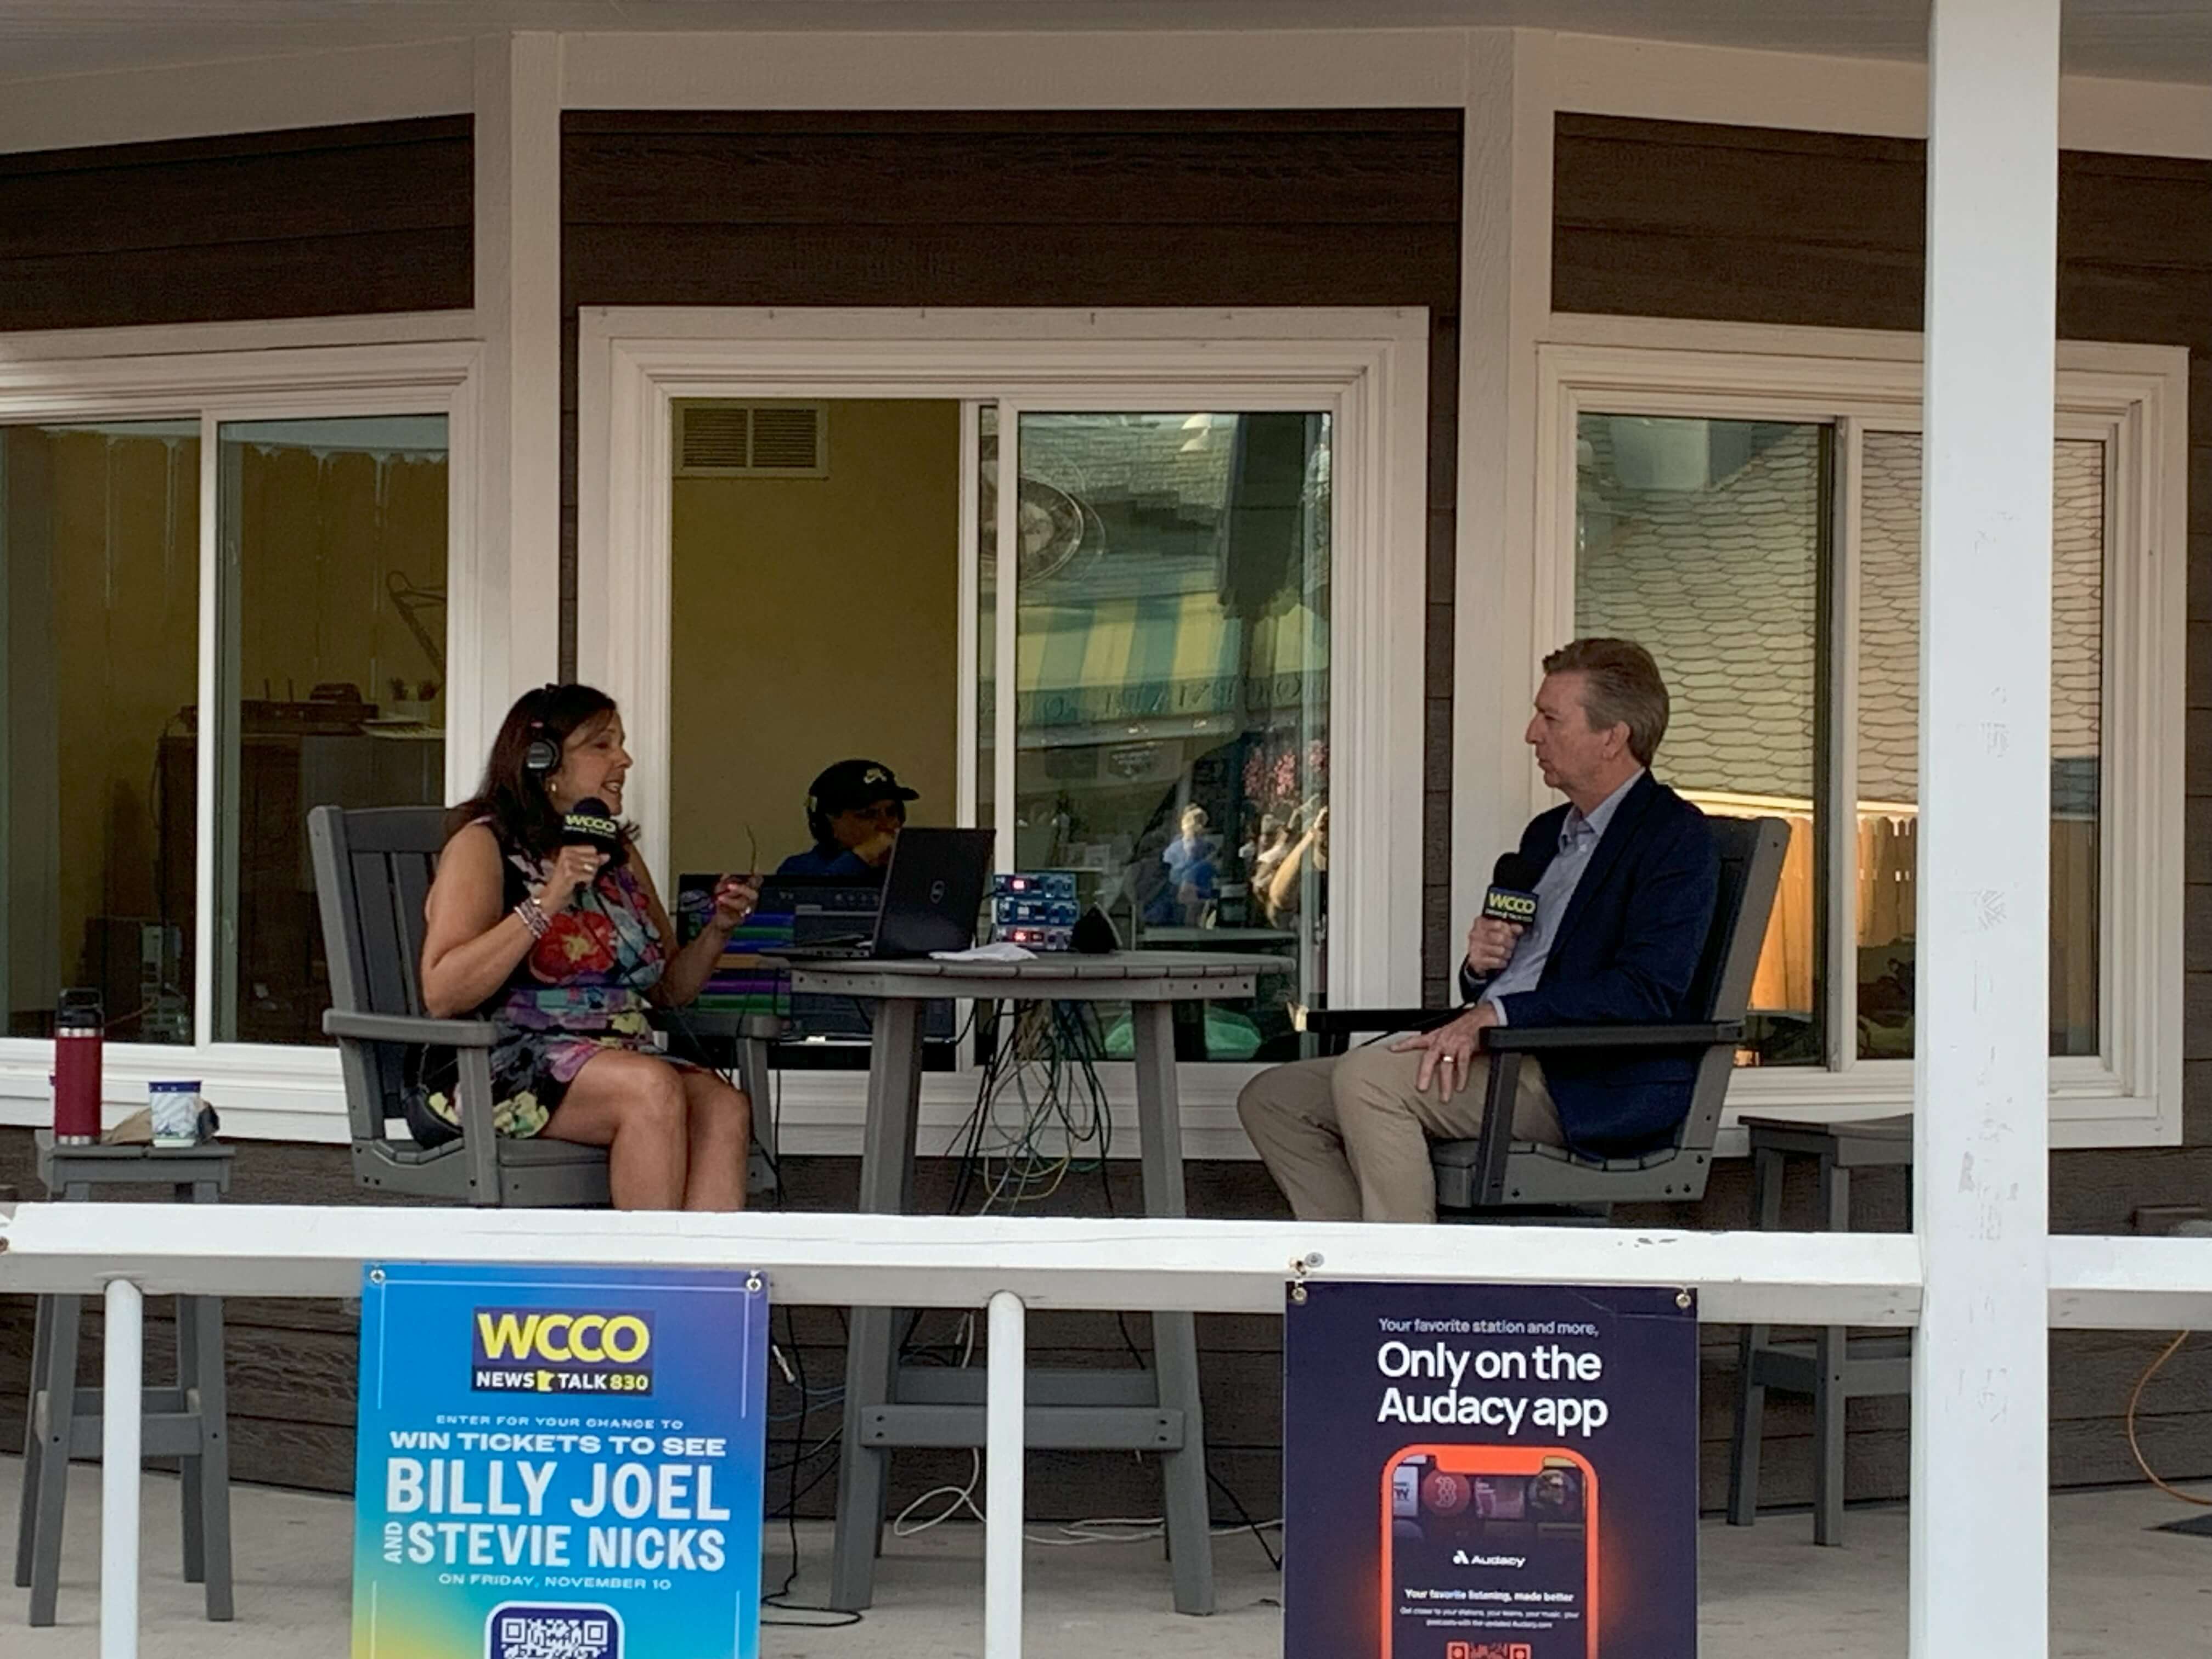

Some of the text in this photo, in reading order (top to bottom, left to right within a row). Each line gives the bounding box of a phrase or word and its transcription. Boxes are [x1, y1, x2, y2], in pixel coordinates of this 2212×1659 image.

[566, 815, 616, 833] WCCO
[1489, 893, 1536, 914] WCCO
[477, 1313, 650, 1362] WCCO
[1379, 1318, 1600, 1336] Your favorite station and more,
[1378, 1341, 1602, 1388] Only on the
[477, 1372, 648, 1391] NEWS TALK 830
[436, 1415, 683, 1430] ENTER FOR YOUR CHANCE TO
[1377, 1387, 1608, 1437] Audacy app
[390, 1431, 726, 1457] WIN TICKETS TO SEE
[387, 1458, 730, 1521] BILLY JOEL
[384, 1521, 726, 1571] AND STEVIE NICKS
[1471, 1555, 1526, 1568] Audacy
[439, 1573, 672, 1590] ON FRIDAY, NOVEMBER 10
